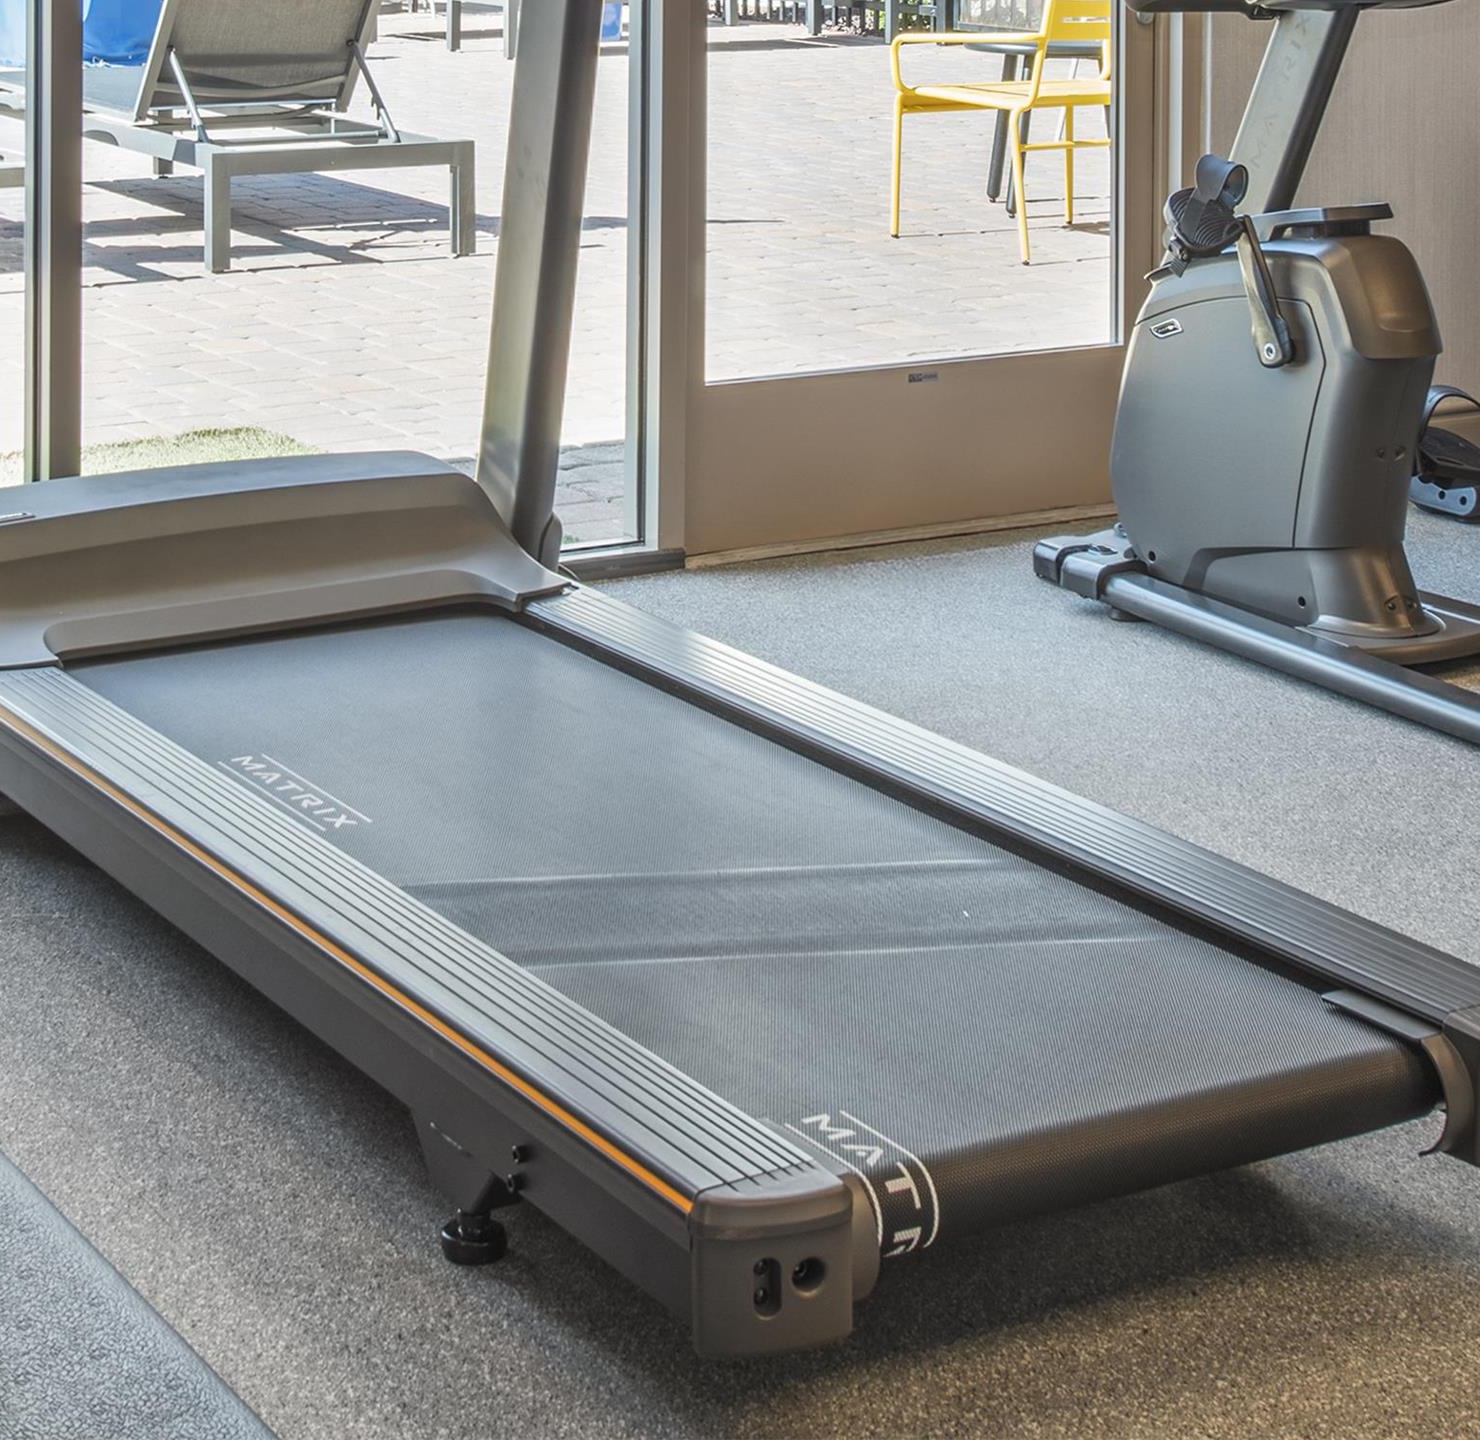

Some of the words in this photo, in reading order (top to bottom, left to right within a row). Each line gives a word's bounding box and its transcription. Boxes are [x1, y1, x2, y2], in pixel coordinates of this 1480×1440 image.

[1250, 13, 1313, 170] MARIX
[231, 755, 358, 829] MATRIX
[801, 1113, 921, 1258] MATR
